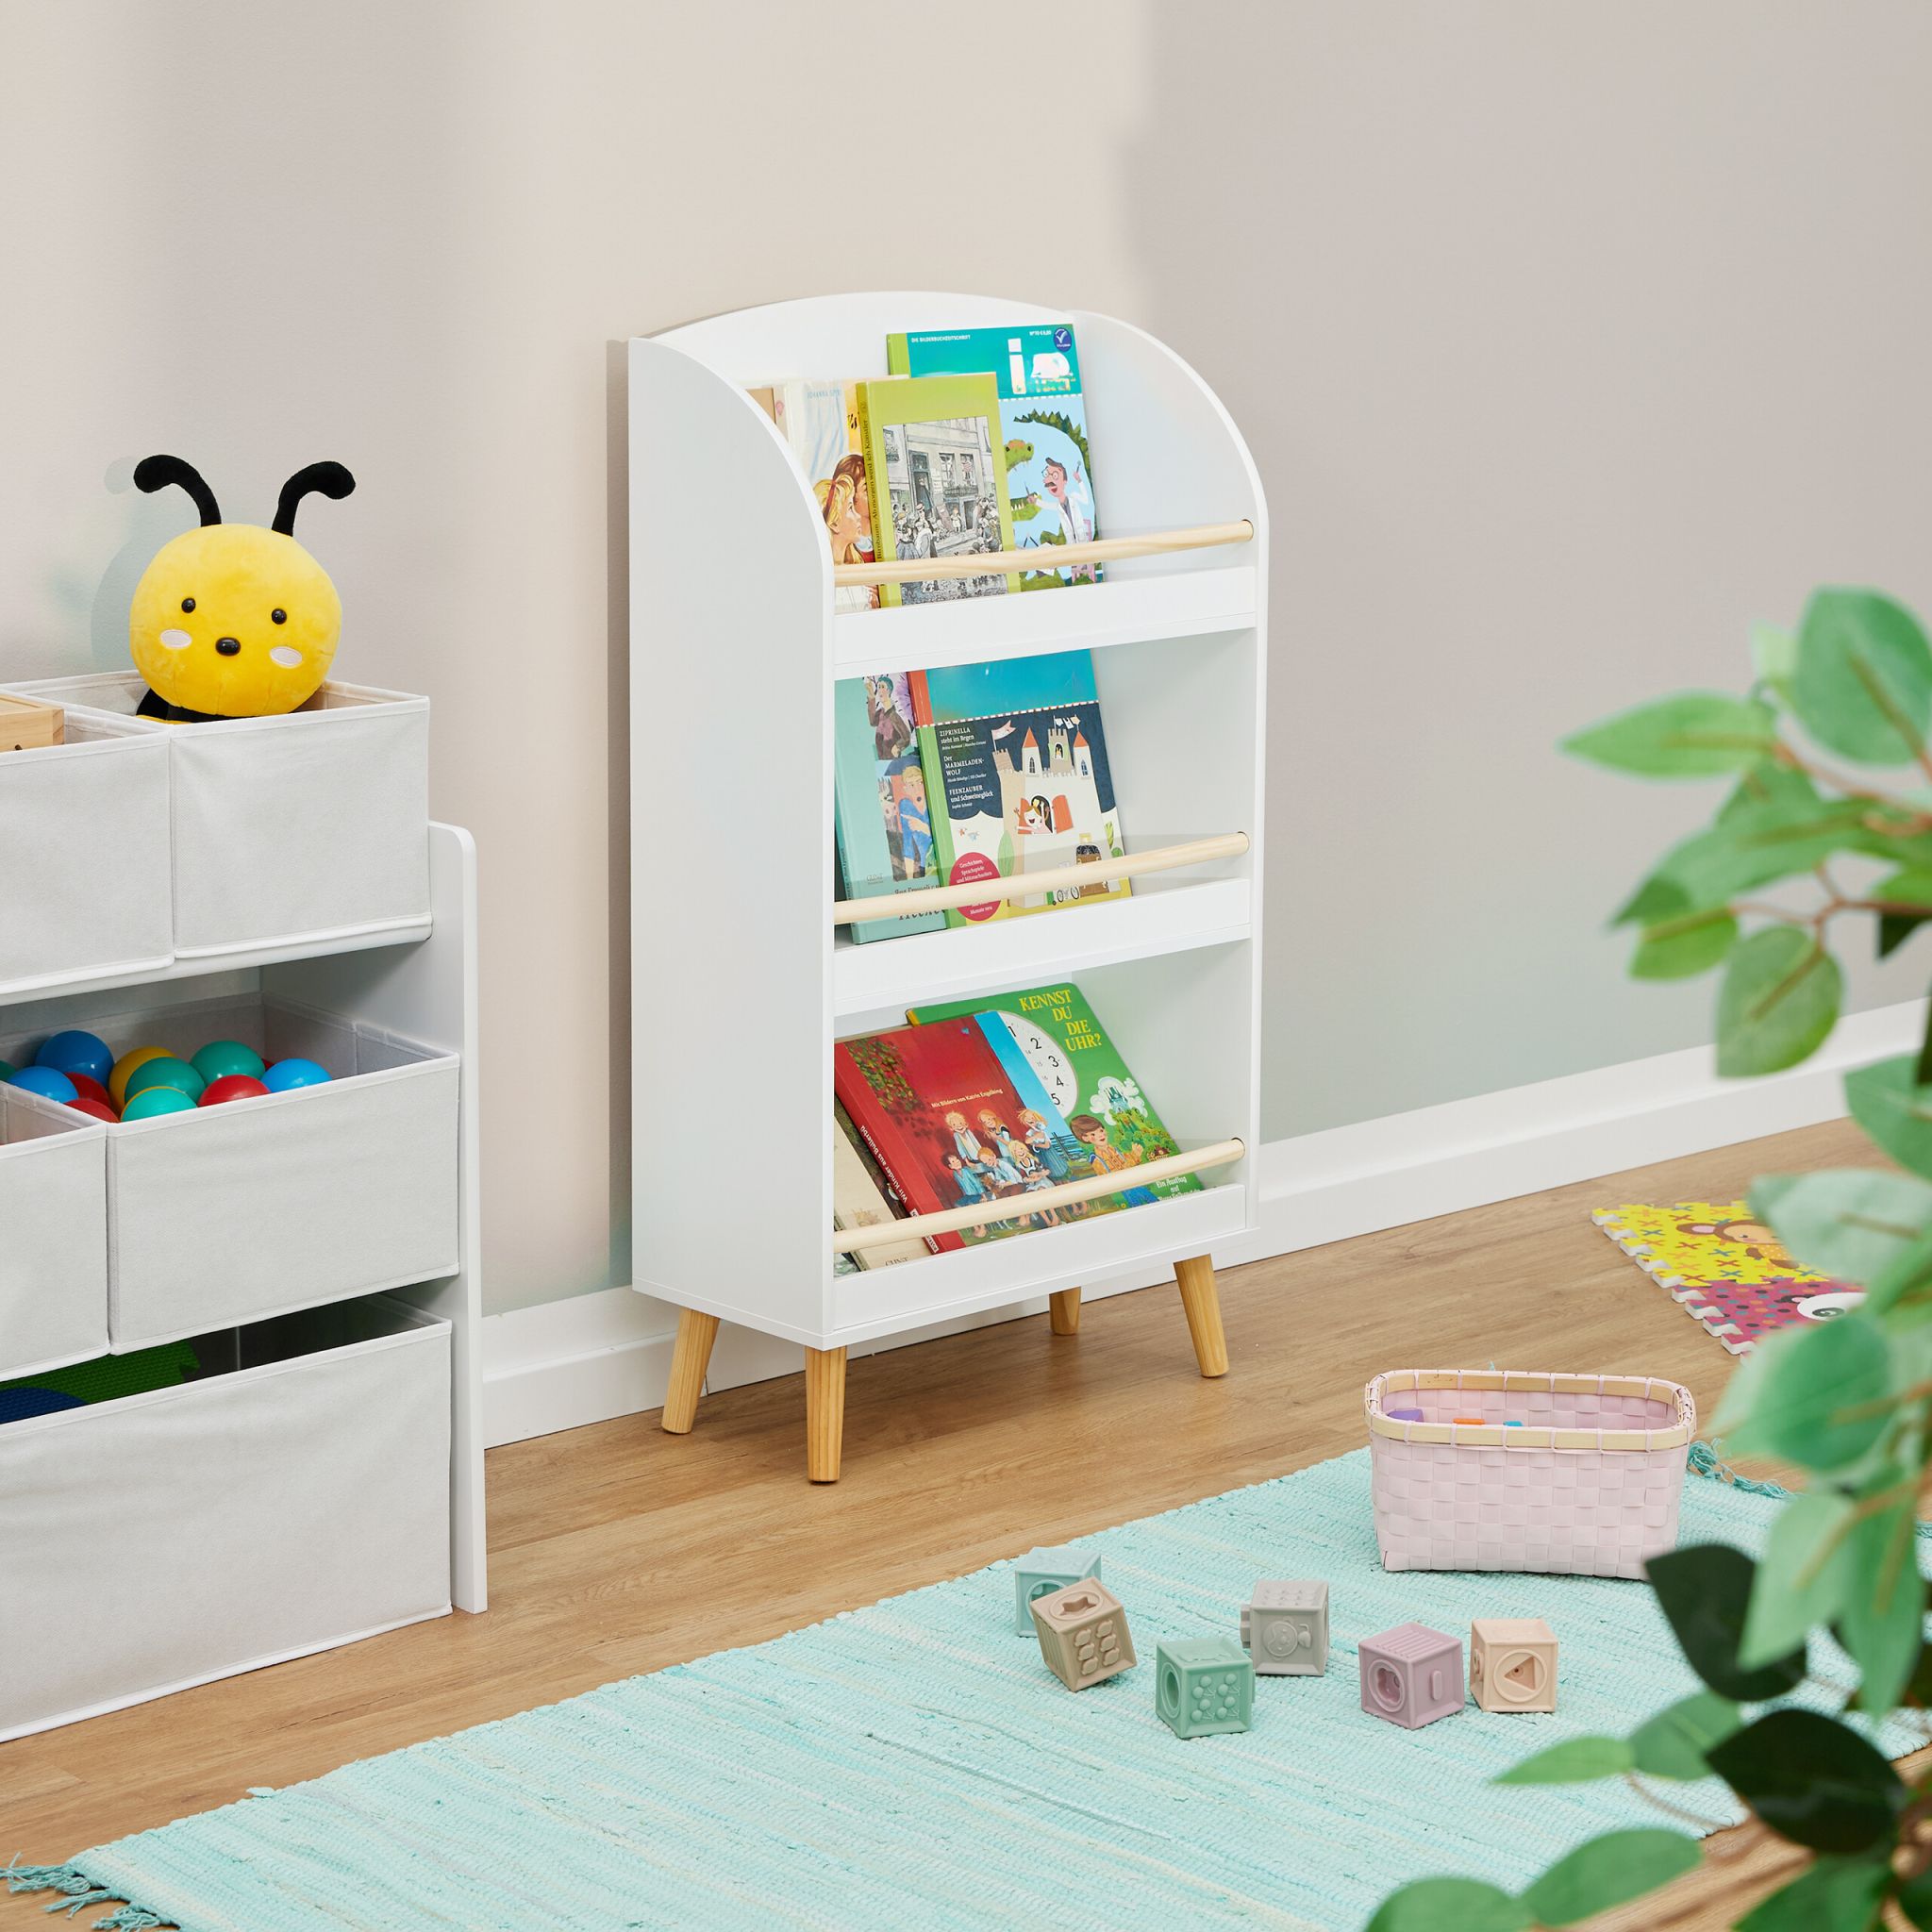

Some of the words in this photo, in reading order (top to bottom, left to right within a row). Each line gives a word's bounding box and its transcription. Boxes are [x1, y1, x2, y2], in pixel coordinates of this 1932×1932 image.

[1019, 989, 1073, 1012] KENNST
[1052, 1006, 1073, 1022] DU
[1065, 1019, 1091, 1036] DIE
[1030, 1037, 1042, 1050] 2
[1065, 1033, 1103, 1052] UHR?
[1048, 1055, 1059, 1068] 3
[1056, 1074, 1064, 1087] 4
[1050, 1092, 1061, 1106] 5
[860, 1124, 879, 1155] Bullerbü
[877, 1153, 887, 1167] aus
[885, 1166, 901, 1190] Kinder
[898, 1189, 908, 1204] Wir
